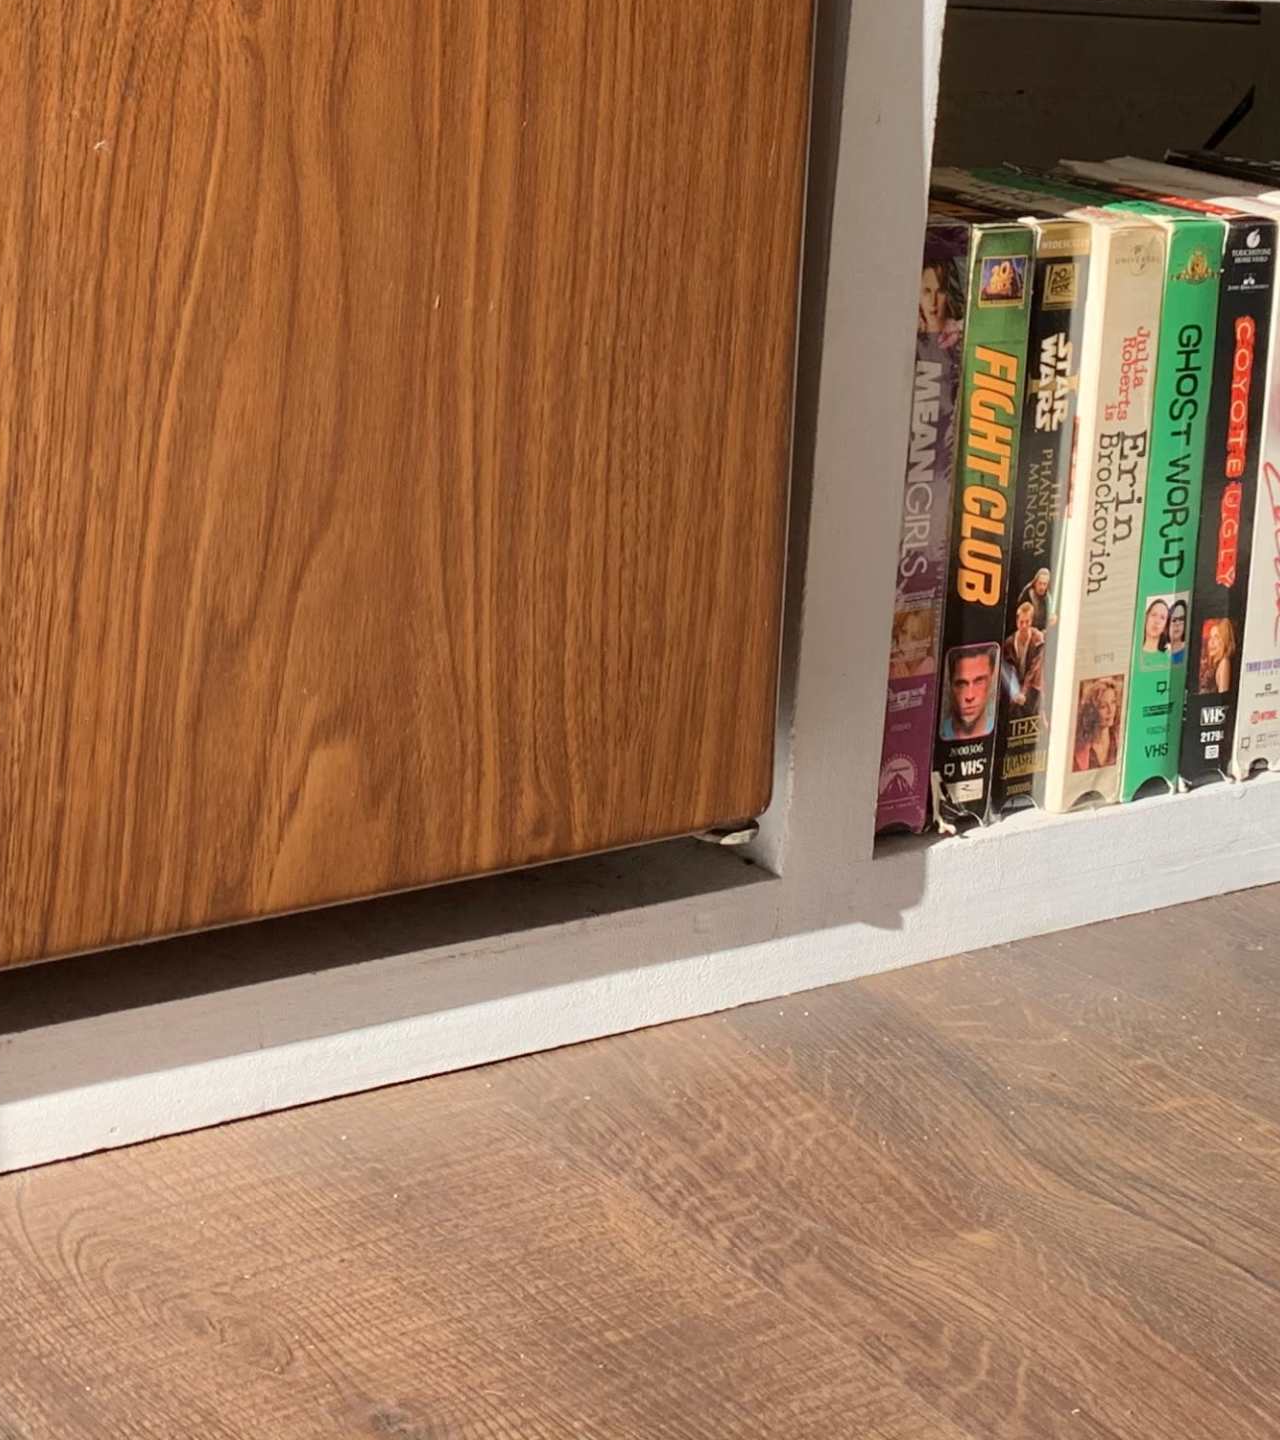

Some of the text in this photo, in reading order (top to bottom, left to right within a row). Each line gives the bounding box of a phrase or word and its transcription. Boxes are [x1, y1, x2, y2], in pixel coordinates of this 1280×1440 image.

[1034, 336, 1058, 432] WARS
[1044, 332, 1072, 432] STAR
[1117, 337, 1138, 421] Roberts
[1133, 326, 1151, 389] Julia
[1168, 323, 1204, 447] GHOST
[1105, 403, 1118, 422] is
[1216, 318, 1255, 588] COYOTE UGLY
[899, 359, 943, 578] MEAN GIRLS
[956, 345, 1019, 607] FIGHT CLUB
[1024, 463, 1041, 551] MENACE
[1034, 447, 1055, 557] PHANTOM
[1087, 432, 1122, 597] Brockovich
[1113, 430, 1148, 546] Erin
[1158, 452, 1193, 580] WORLD
[1144, 743, 1169, 759] VHS
[1200, 708, 1228, 726] VHS
[961, 758, 988, 777] VHS
